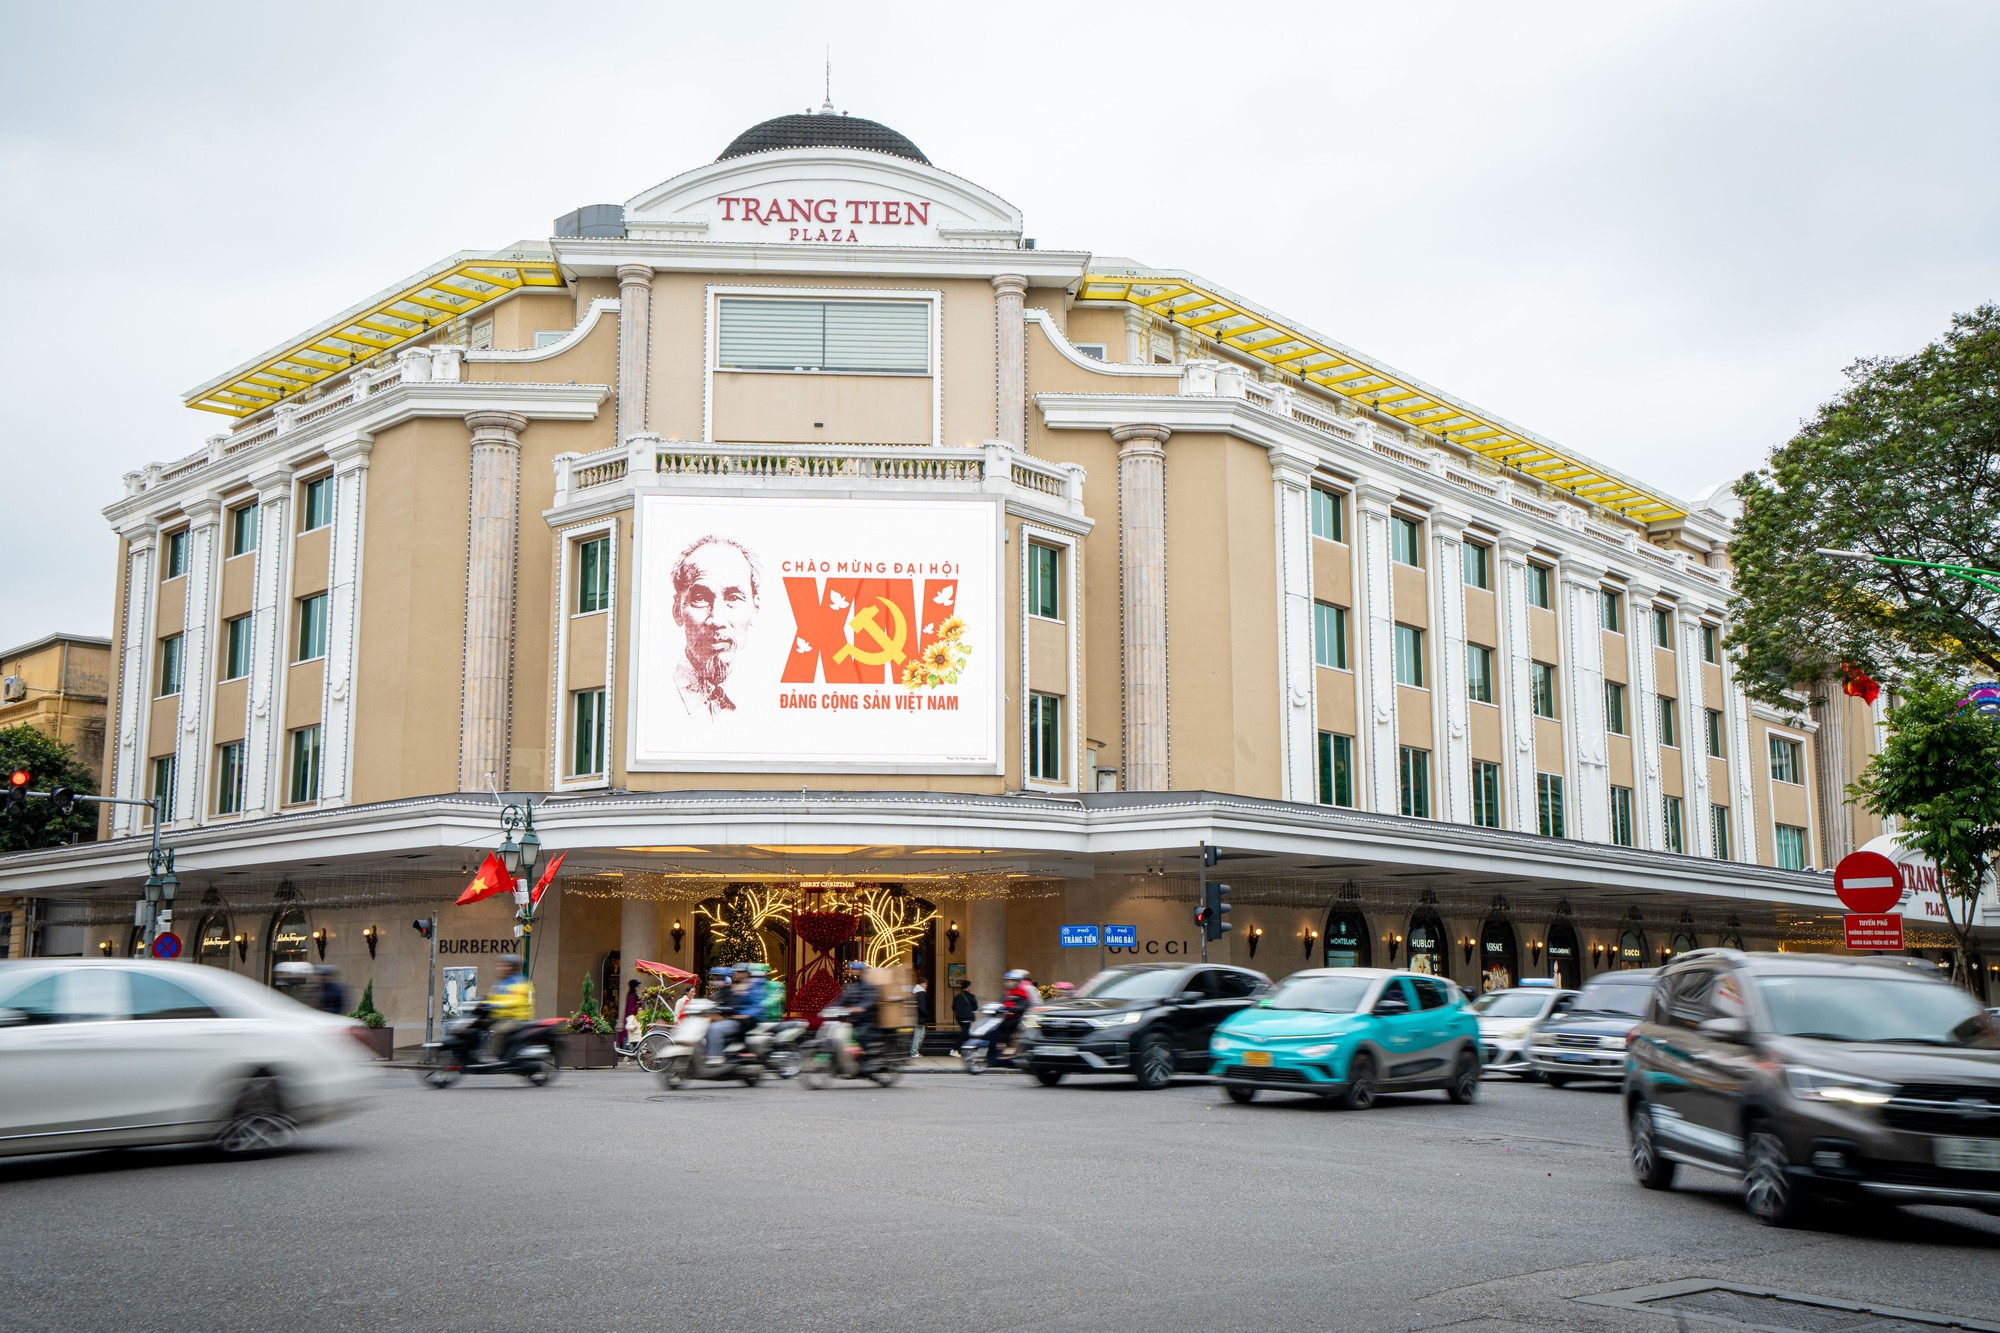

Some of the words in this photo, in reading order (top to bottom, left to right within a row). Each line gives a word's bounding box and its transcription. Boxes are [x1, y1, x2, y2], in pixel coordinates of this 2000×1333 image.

[717, 196, 838, 226] TRANG
[845, 199, 931, 225] TIEN
[789, 227, 859, 242] PLAZA
[781, 558, 831, 573] CHÀO
[837, 559, 887, 574] MỪNG
[893, 562, 923, 577] ĐẠI
[929, 560, 959, 578] HỘI
[780, 576, 959, 685] XIV
[779, 688, 817, 709] ĐẢNG
[821, 690, 859, 713] CỘNG
[863, 689, 892, 710] SẢN
[895, 691, 923, 714] VIỆT
[927, 695, 959, 711] NAM
[1925, 901, 1947, 917] PLAZ
[438, 939, 521, 954] BURBERRY
[1064, 934, 1083, 944] TRÀNG
[1106, 934, 1123, 944] HÀNG
[1123, 935, 1134, 944] BÀI
[1330, 938, 1357, 946] MONTBLANC
[1412, 939, 1435, 948] HUBLOT
[1624, 948, 1640, 957] GUCCI
